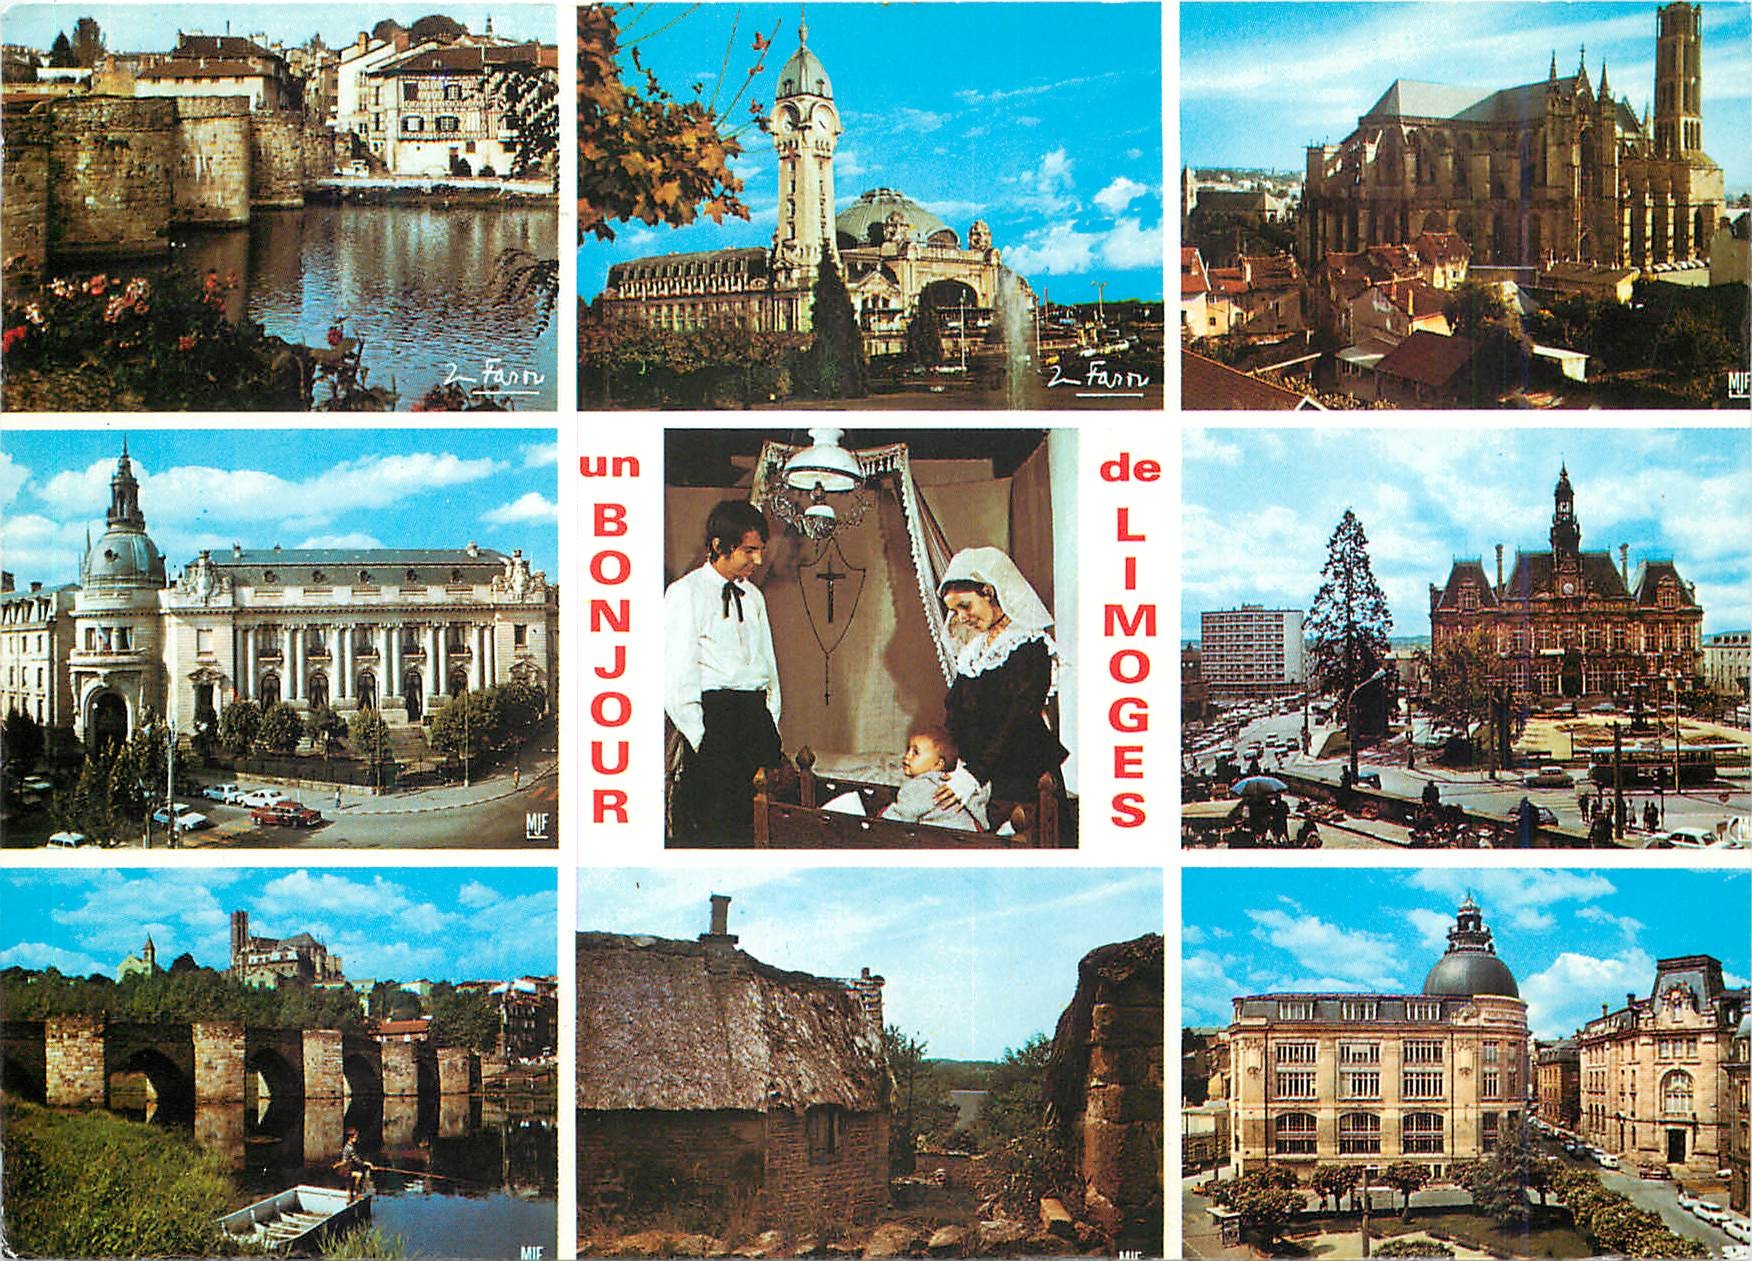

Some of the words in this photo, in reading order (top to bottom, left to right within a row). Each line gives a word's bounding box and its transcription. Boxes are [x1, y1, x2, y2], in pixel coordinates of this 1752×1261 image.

[579, 456, 641, 478] un
[1099, 452, 1162, 483] de
[589, 503, 633, 825] BONJOUR
[1104, 507, 1158, 829] LIMOGES
